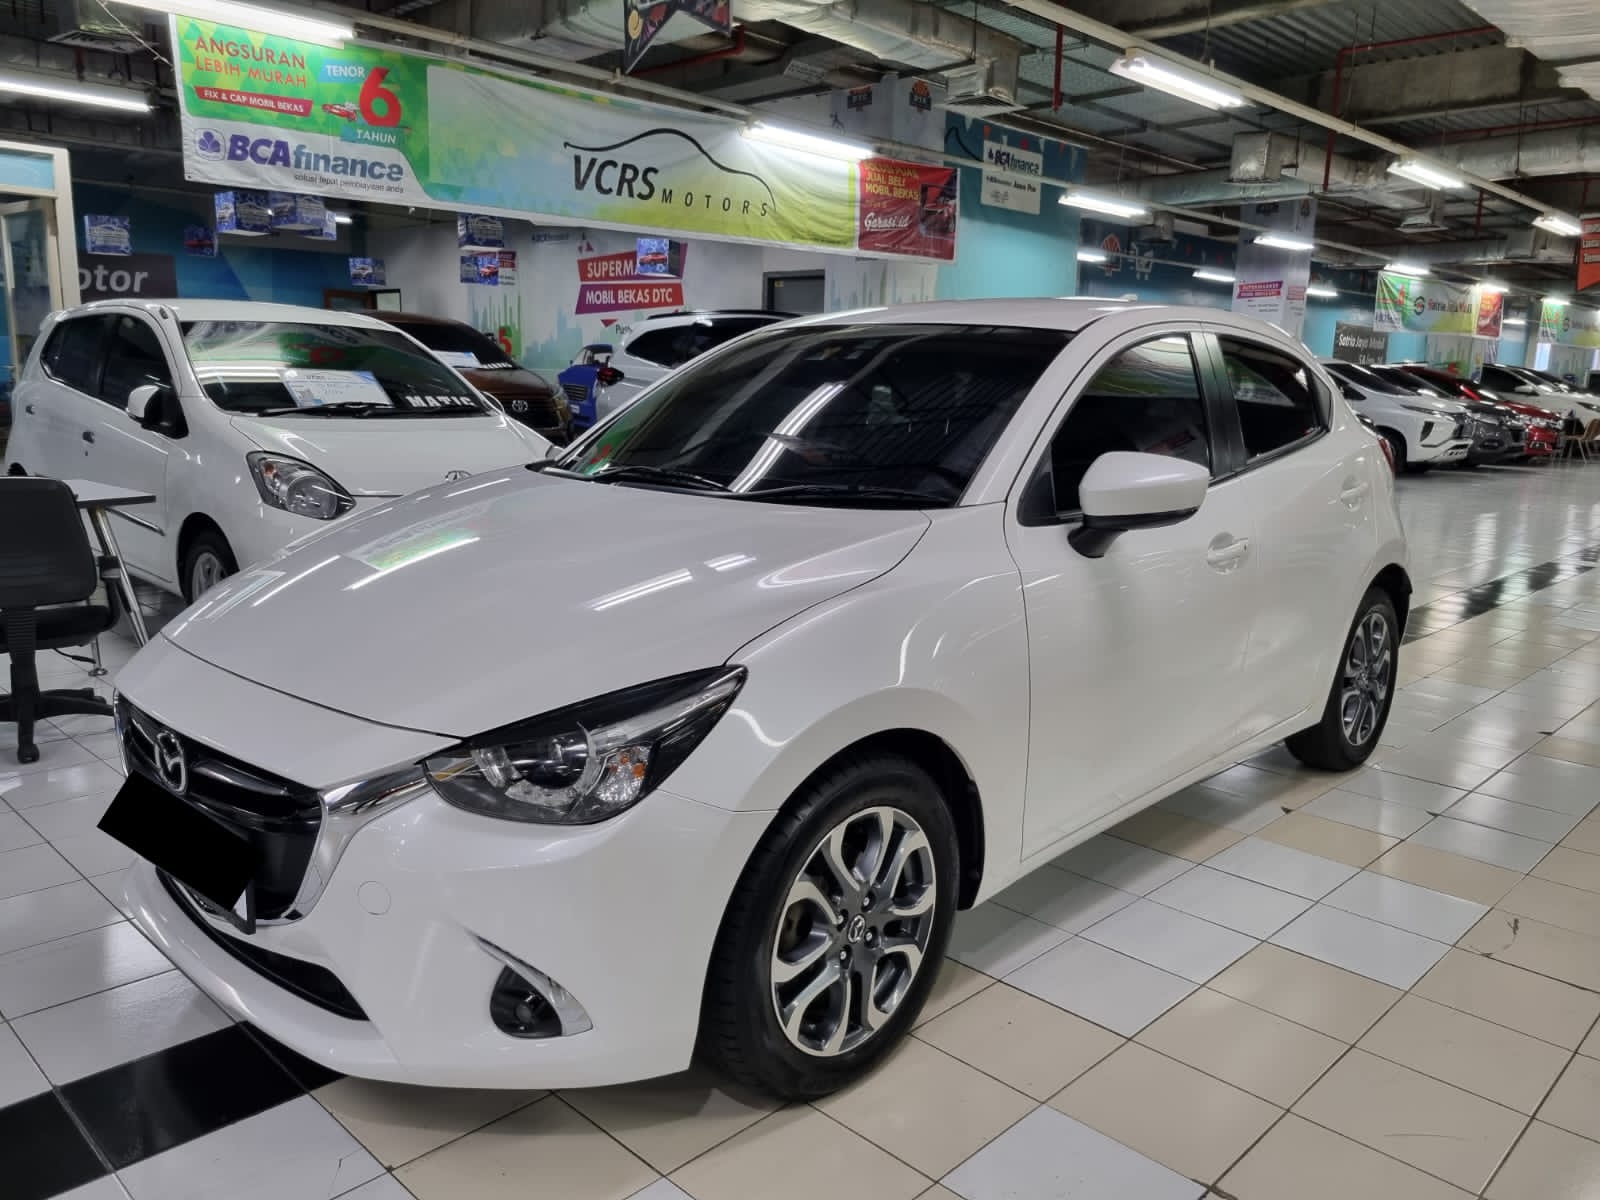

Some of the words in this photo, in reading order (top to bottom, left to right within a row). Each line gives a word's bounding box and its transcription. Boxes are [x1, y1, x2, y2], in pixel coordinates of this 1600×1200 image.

[195, 35, 305, 70] ANGSURAN
[195, 55, 240, 77] LEBIH
[248, 66, 306, 89] MURAH
[326, 64, 366, 78] TENOR
[204, 89, 218, 99] FIX
[221, 93, 228, 101] &
[229, 94, 247, 104] CAP
[249, 96, 275, 109] MOBIL
[277, 100, 304, 113] BEKAS
[359, 66, 402, 127] 6
[356, 129, 396, 144] TAHUN
[227, 134, 290, 168] BCA
[294, 144, 404, 182] finance
[574, 155, 659, 200] VCRS
[661, 188, 768, 217] MOTORS
[866, 170, 886, 184] JUAL
[865, 183, 890, 196] MOBIL
[585, 289, 616, 305] MOBIL
[617, 288, 650, 304] BEKAS
[652, 287, 673, 303] DTC
[405, 395, 477, 407] MATIC
